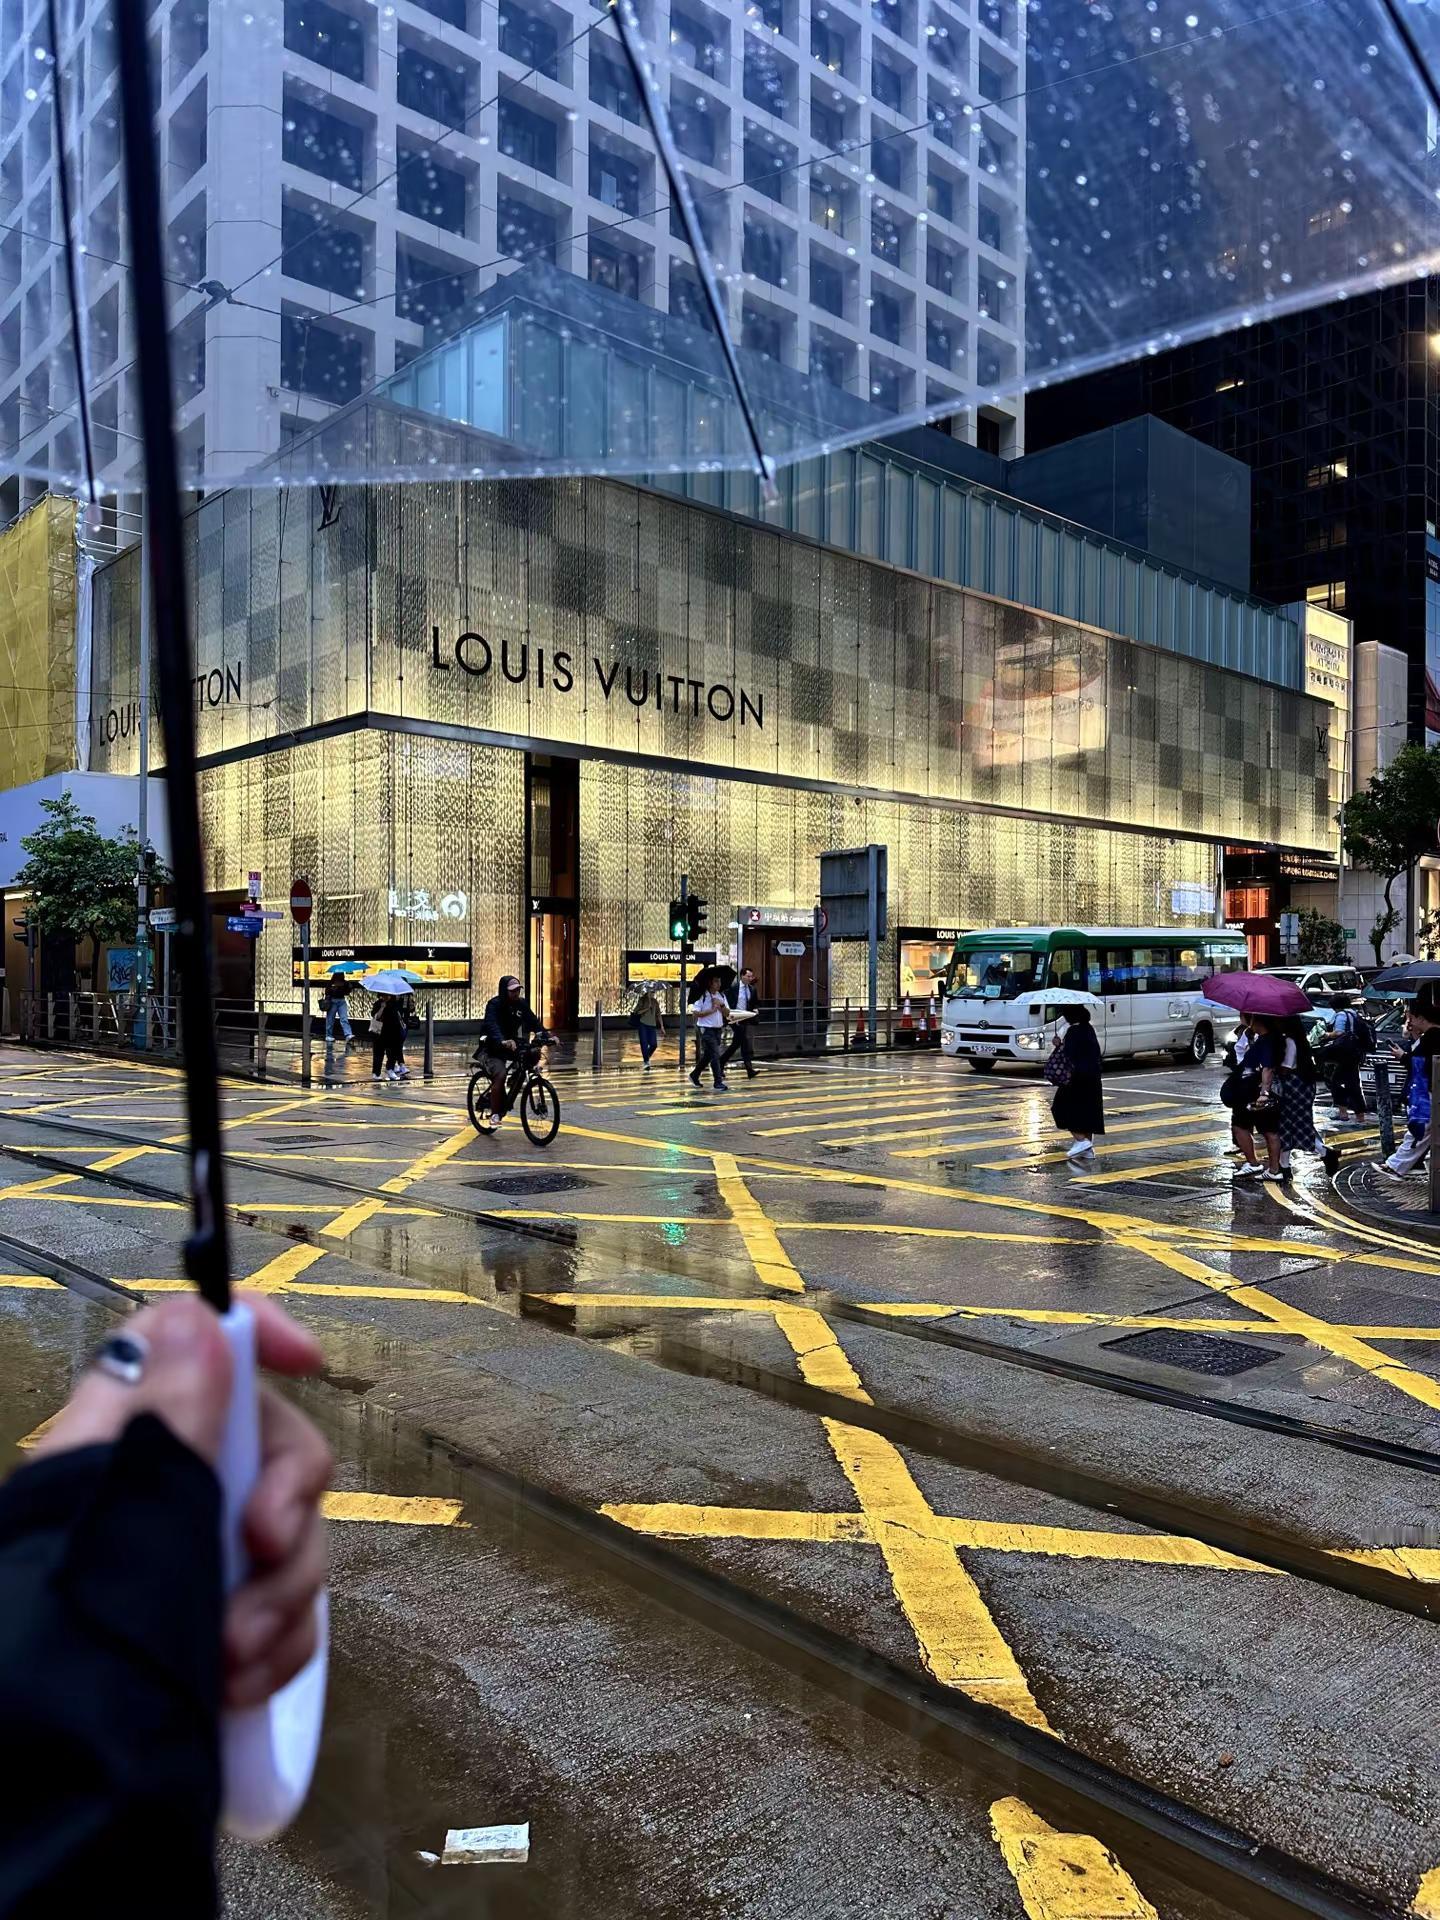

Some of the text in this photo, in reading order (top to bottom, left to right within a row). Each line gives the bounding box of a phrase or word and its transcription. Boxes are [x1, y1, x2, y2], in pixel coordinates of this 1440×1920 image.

[432, 626, 764, 730] LOUIS VUITTON
[936, 930, 955, 939] LOUIS
[321, 949, 335, 957] LOUIS
[650, 952, 696, 961] LOUIS VUION
